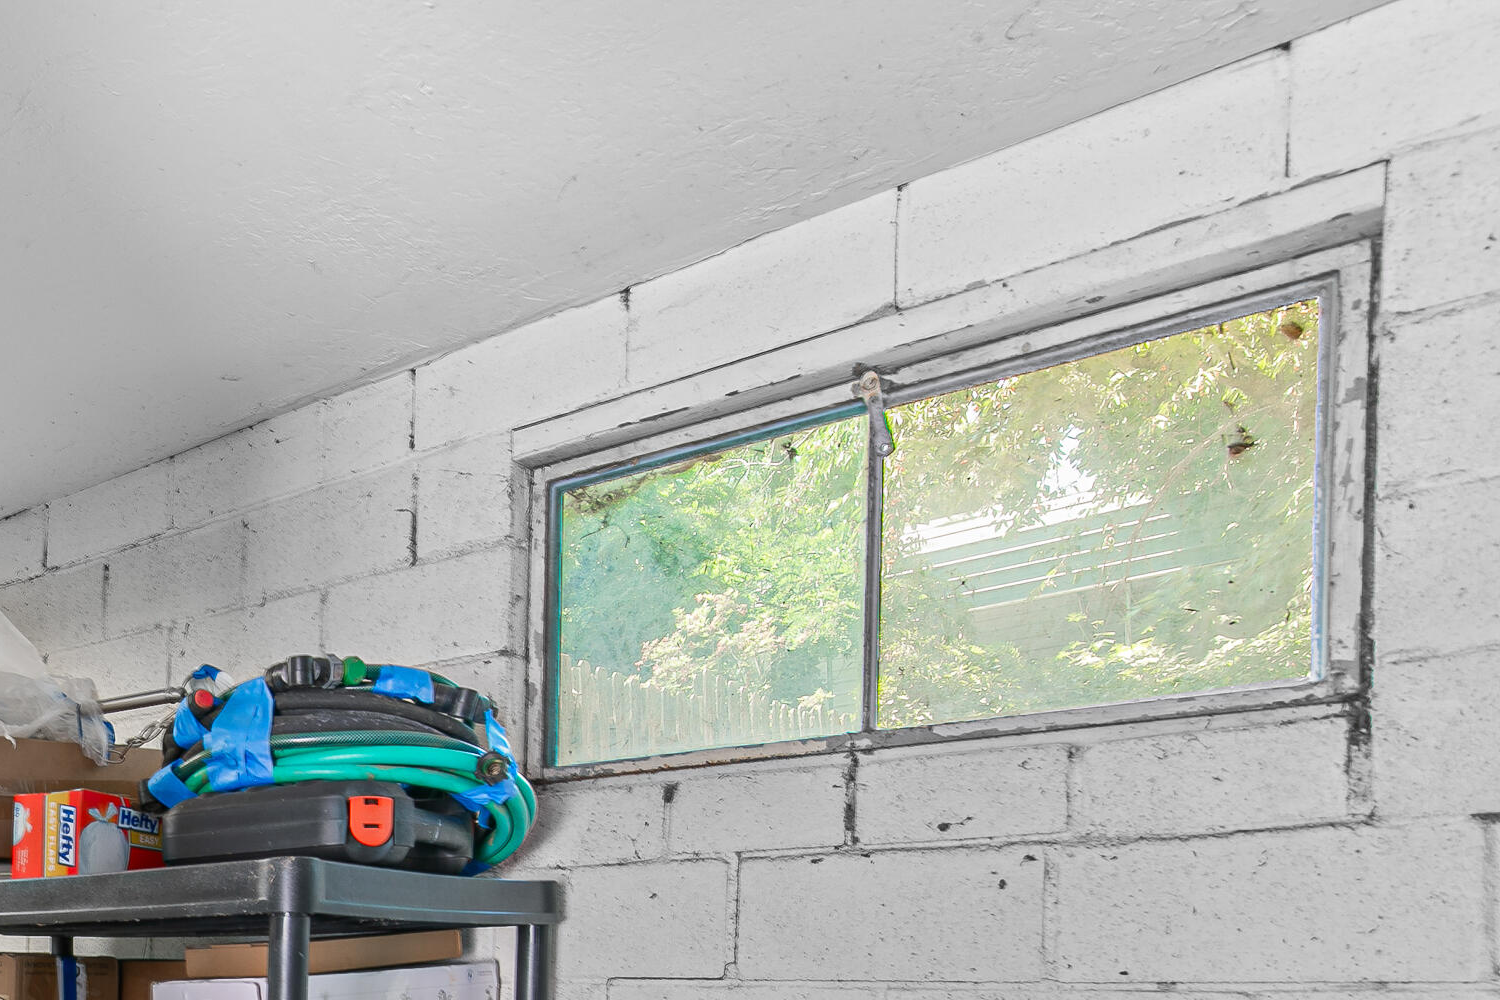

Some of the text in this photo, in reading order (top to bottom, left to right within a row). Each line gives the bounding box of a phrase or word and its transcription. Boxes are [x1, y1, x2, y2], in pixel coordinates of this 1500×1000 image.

[121, 810, 158, 832] Hefty
[60, 809, 74, 863] Hefty
[139, 834, 159, 846] EASY
[48, 836, 56, 872] FLAPS
